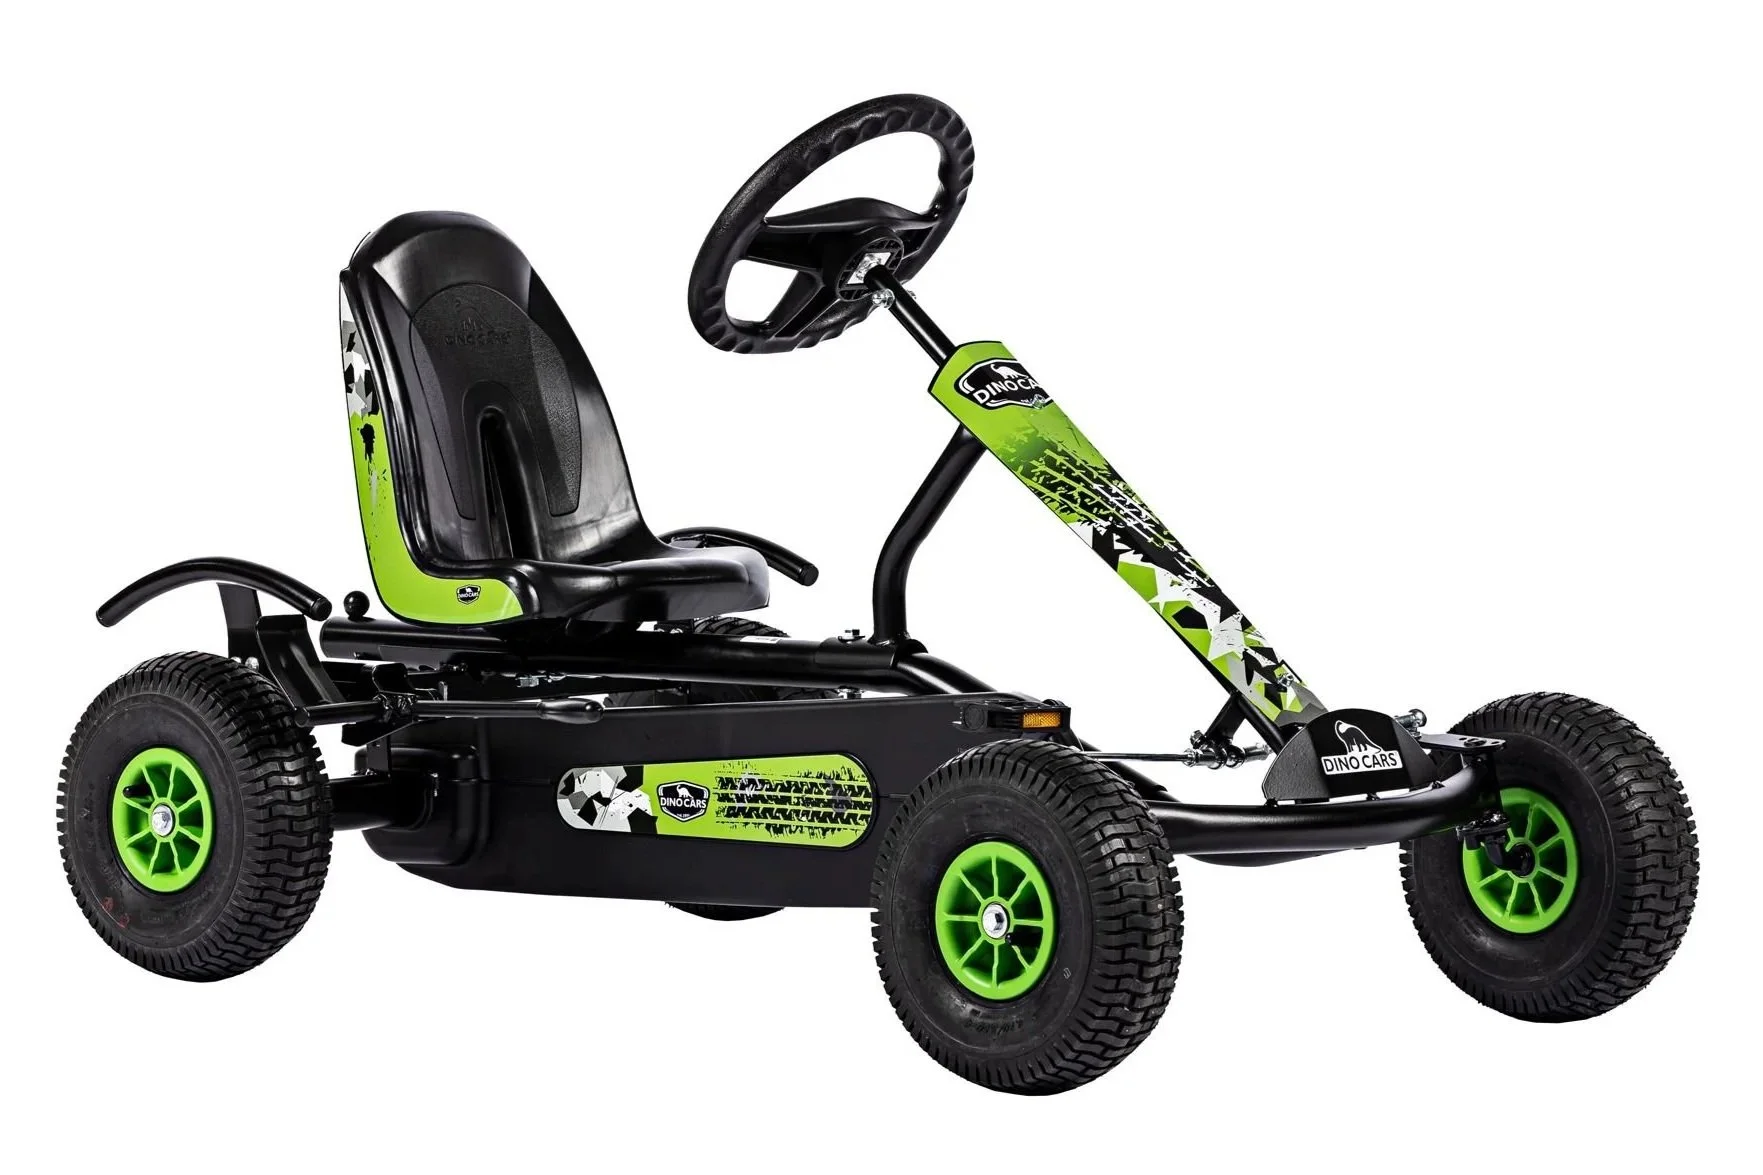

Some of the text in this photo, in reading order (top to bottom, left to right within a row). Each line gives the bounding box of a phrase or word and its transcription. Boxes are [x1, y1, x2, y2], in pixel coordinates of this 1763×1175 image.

[445, 334, 475, 346] DINO
[972, 379, 1019, 405] DINO
[1017, 378, 1043, 391] CA
[1323, 753, 1398, 773] DINO CARS
[660, 797, 707, 809] DINO CARS
